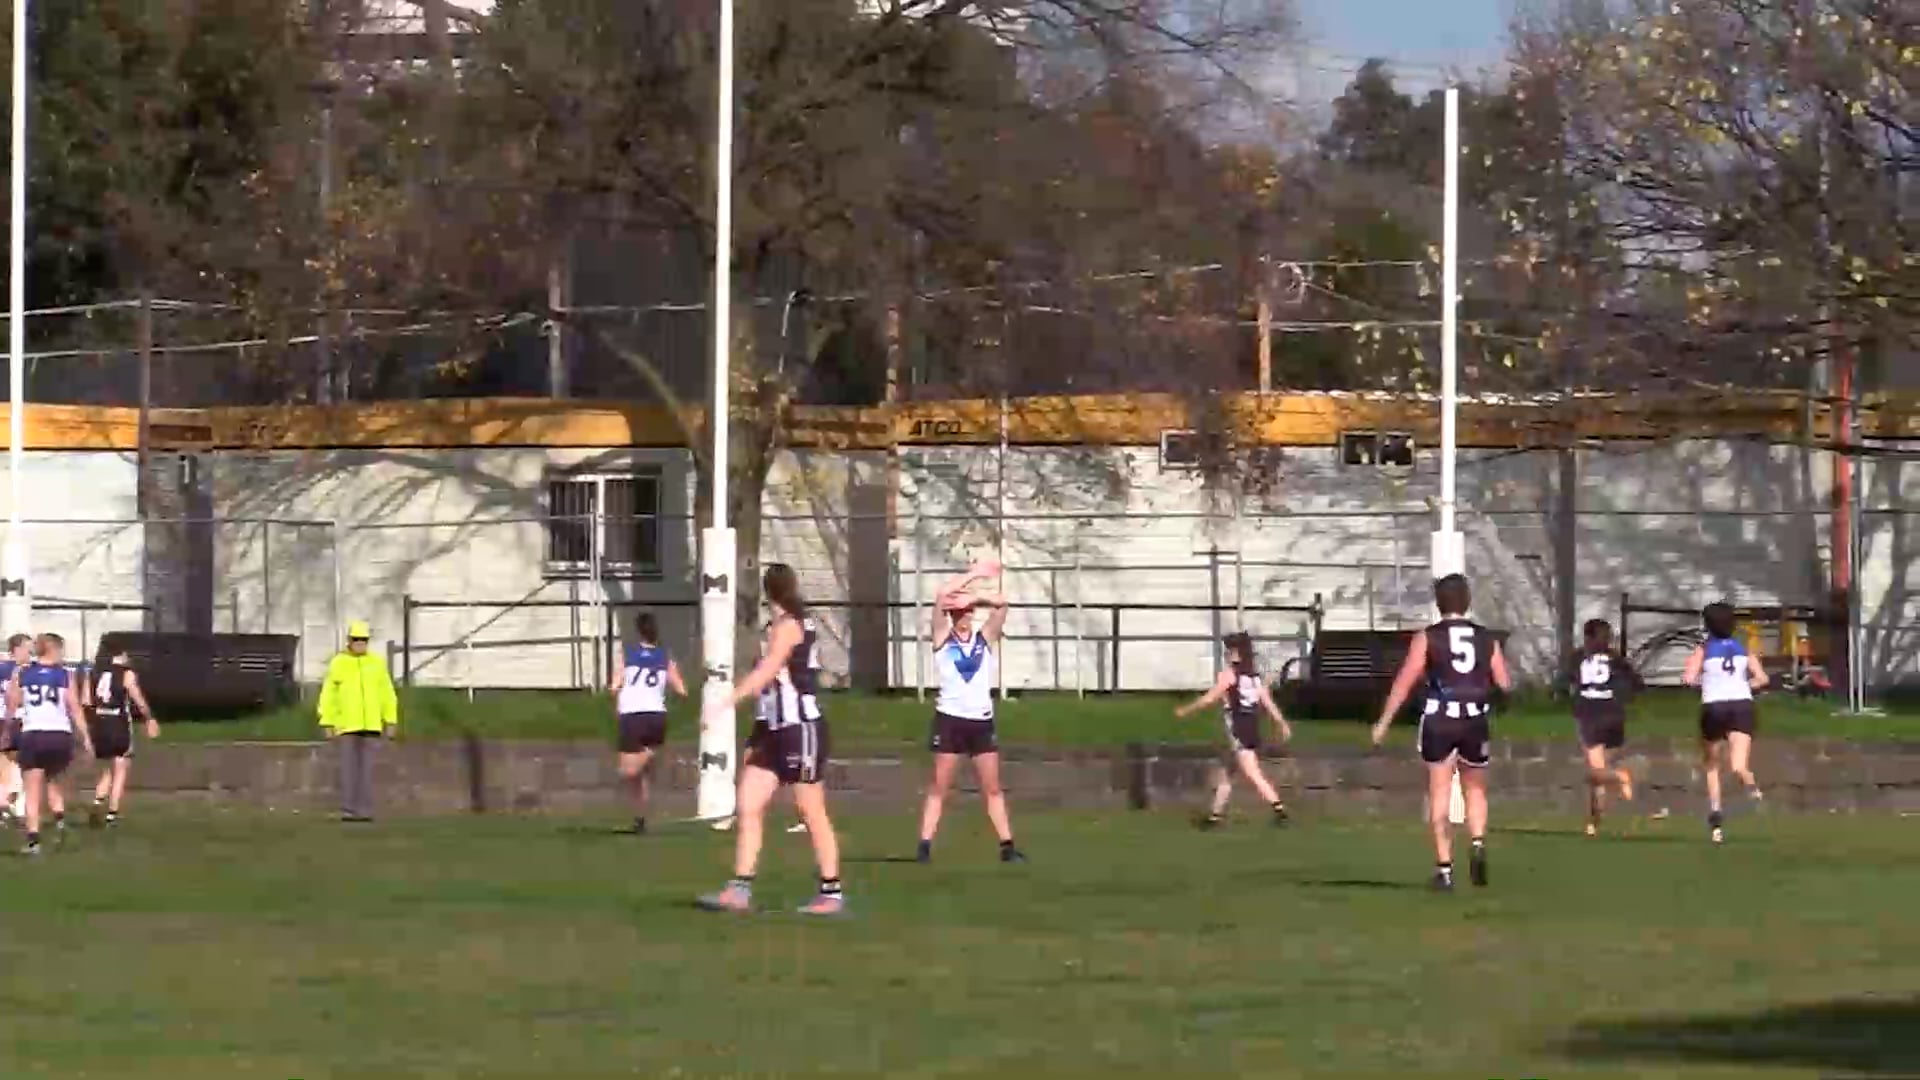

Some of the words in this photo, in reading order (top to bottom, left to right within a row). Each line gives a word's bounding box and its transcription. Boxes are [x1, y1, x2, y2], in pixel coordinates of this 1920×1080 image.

[1449, 626, 1476, 674] 5
[1721, 656, 1736, 675] 4
[96, 671, 112, 702] 4
